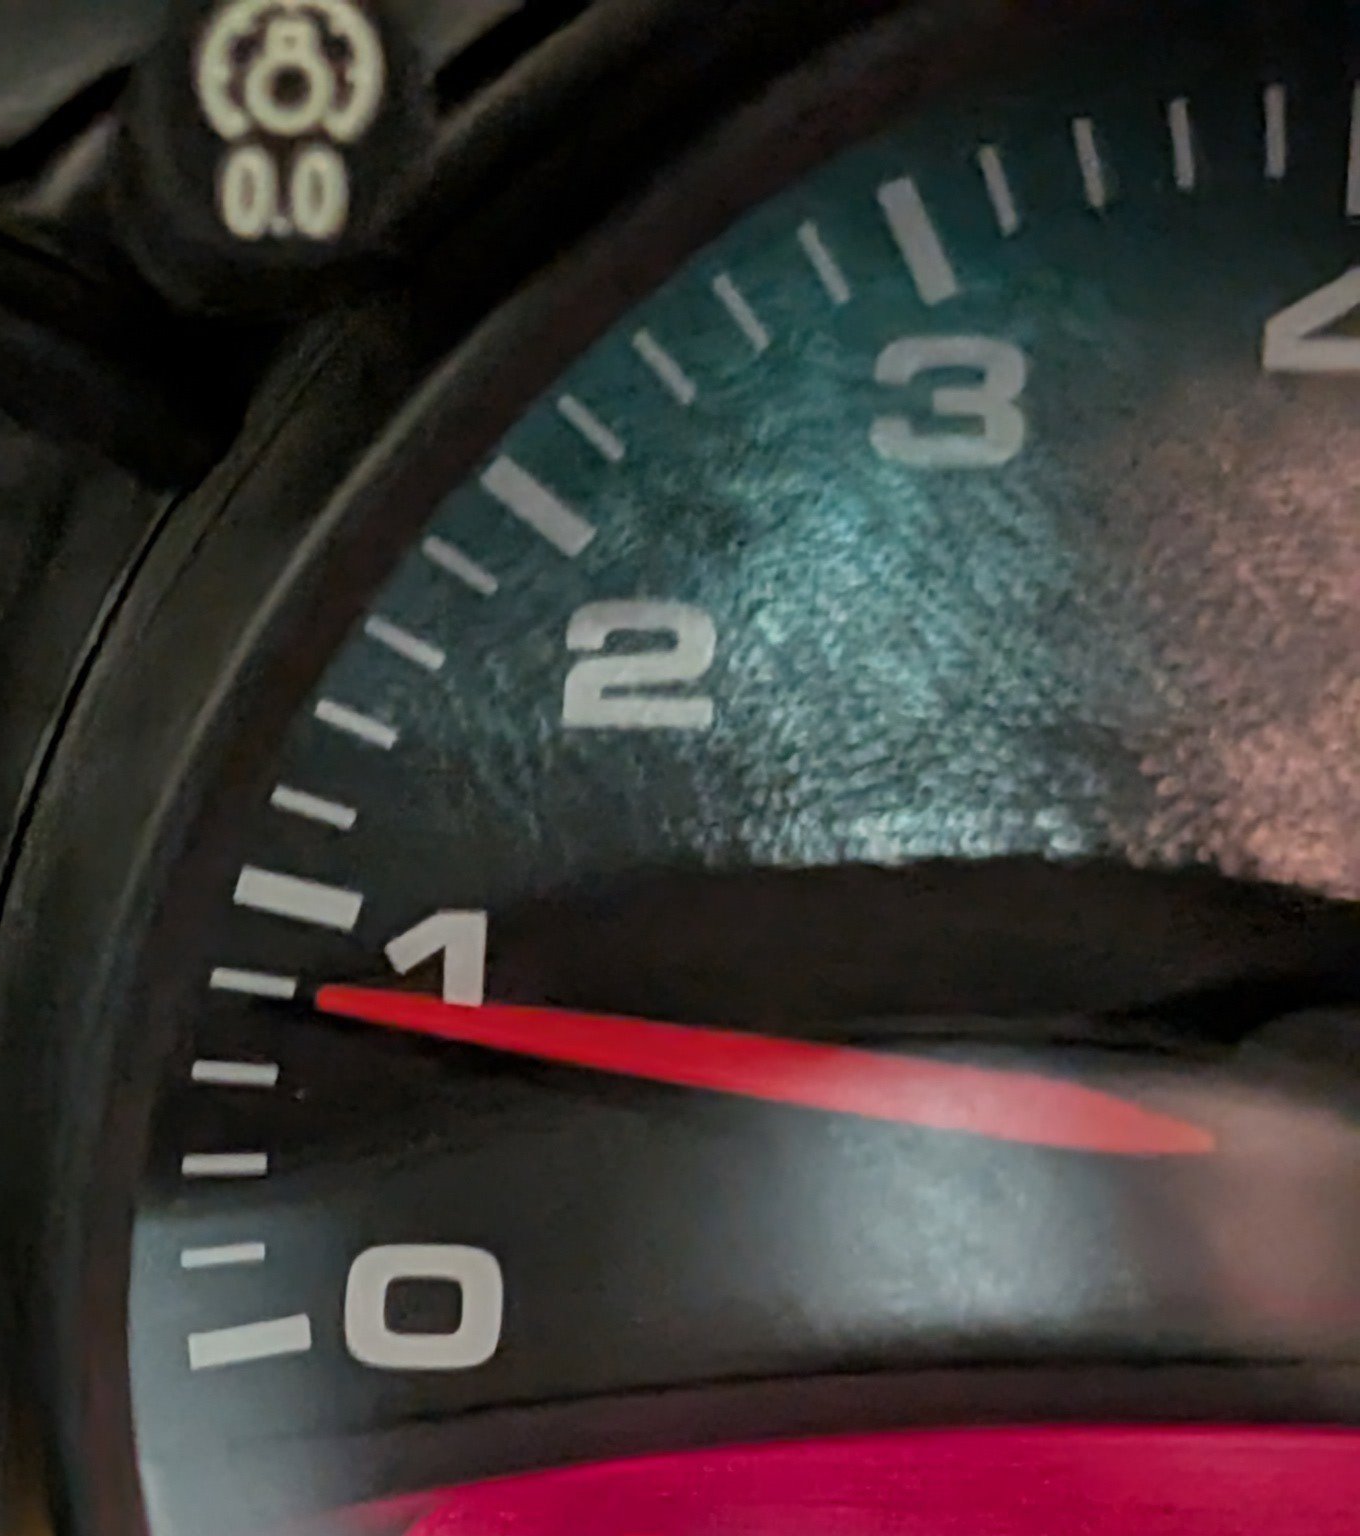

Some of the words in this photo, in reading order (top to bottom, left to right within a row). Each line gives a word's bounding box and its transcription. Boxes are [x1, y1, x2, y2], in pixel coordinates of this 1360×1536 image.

[868, 335, 1027, 468] 3
[561, 600, 718, 731] 2
[384, 910, 488, 1007] 1
[344, 1244, 504, 1370] 0
